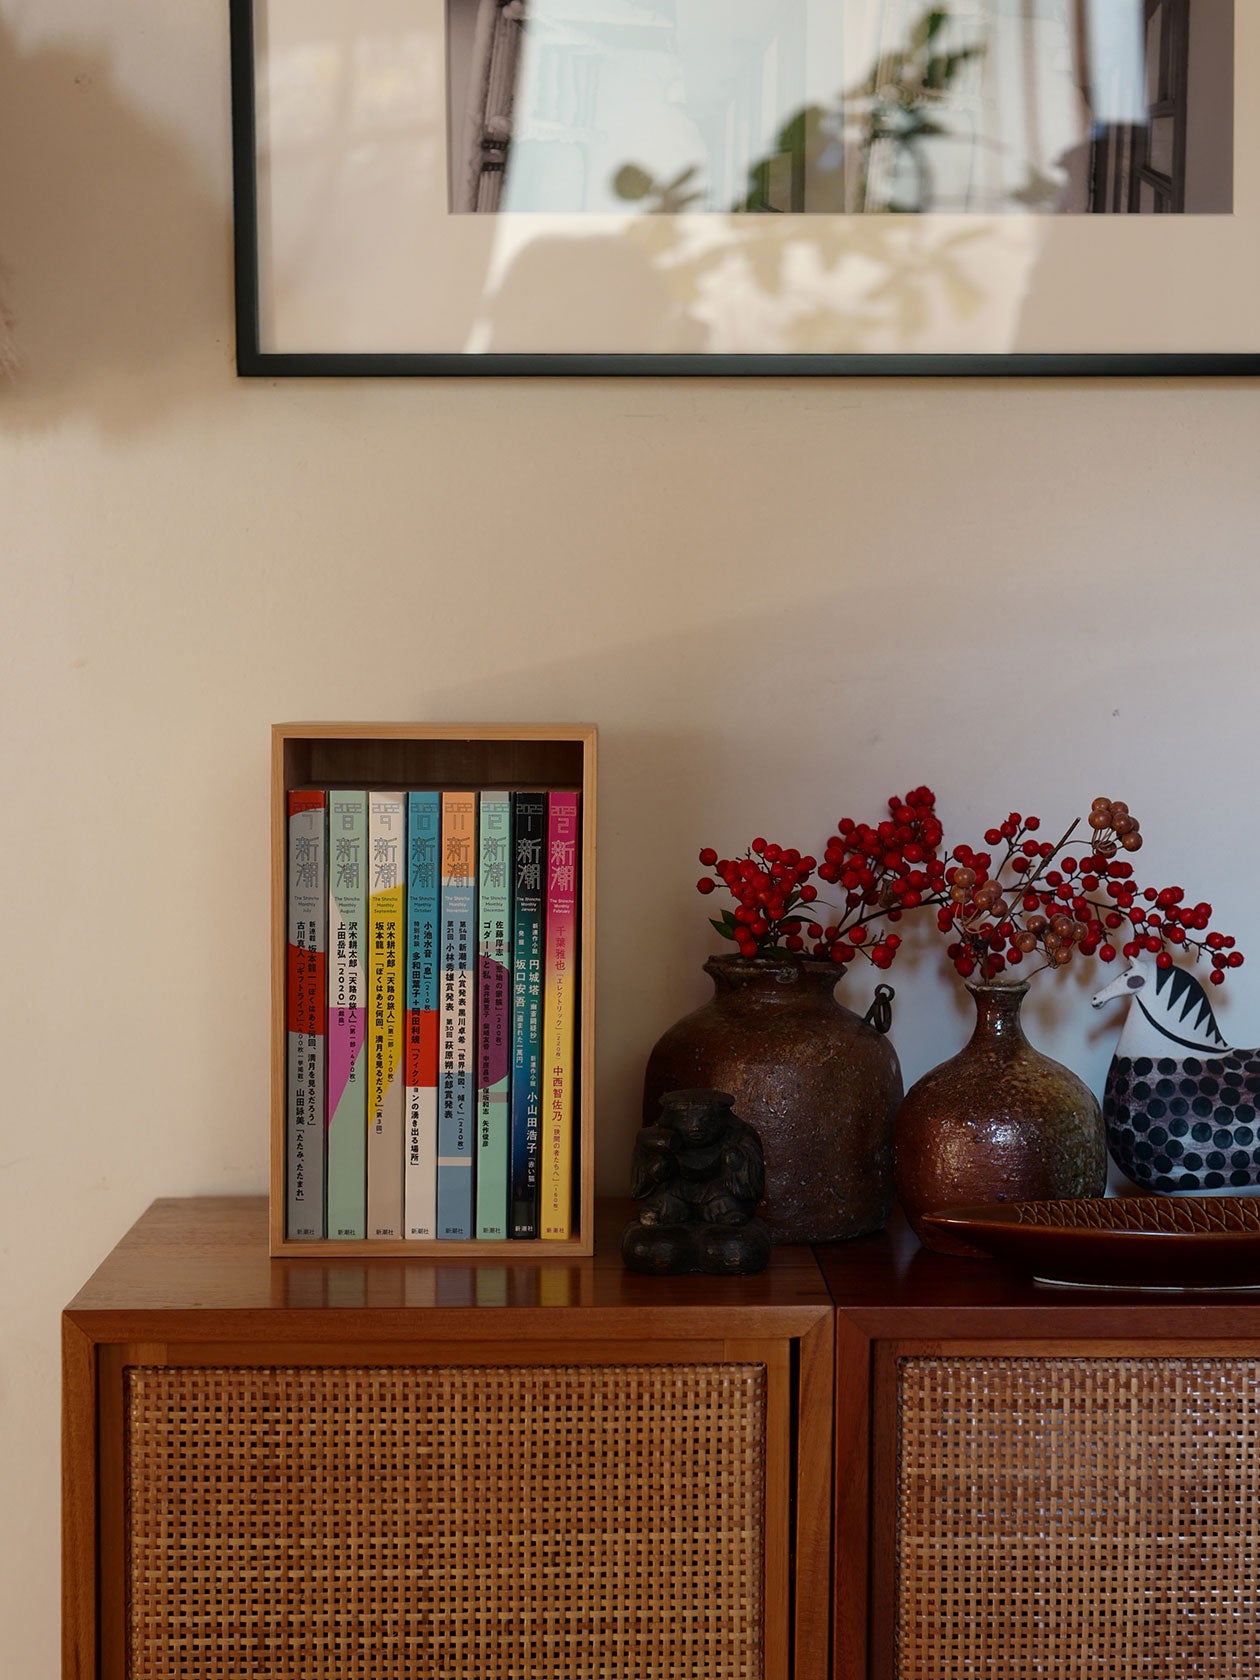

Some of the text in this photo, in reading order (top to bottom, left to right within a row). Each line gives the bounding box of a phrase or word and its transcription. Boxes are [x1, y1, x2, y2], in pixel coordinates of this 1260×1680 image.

[302, 814, 313, 830] 7
[342, 815, 353, 830] 8
[380, 815, 391, 831] 9
[417, 815, 431, 831] 10
[453, 814, 464, 830] 11
[488, 814, 502, 830] 12
[527, 816, 532, 832] 1
[558, 817, 569, 833] 2
[296, 837, 319, 888] 新潮
[336, 838, 360, 888] 新潮
[374, 838, 398, 888] 新潮
[412, 837, 436, 888] 新潮
[447, 837, 470, 888] 新潮
[483, 837, 506, 888] 新潮
[518, 838, 541, 890] 新潮
[551, 841, 575, 892] 新潮
[483, 921, 492, 979] ゴダールと私
[446, 943, 455, 1011] 小林秀雄賞発表
